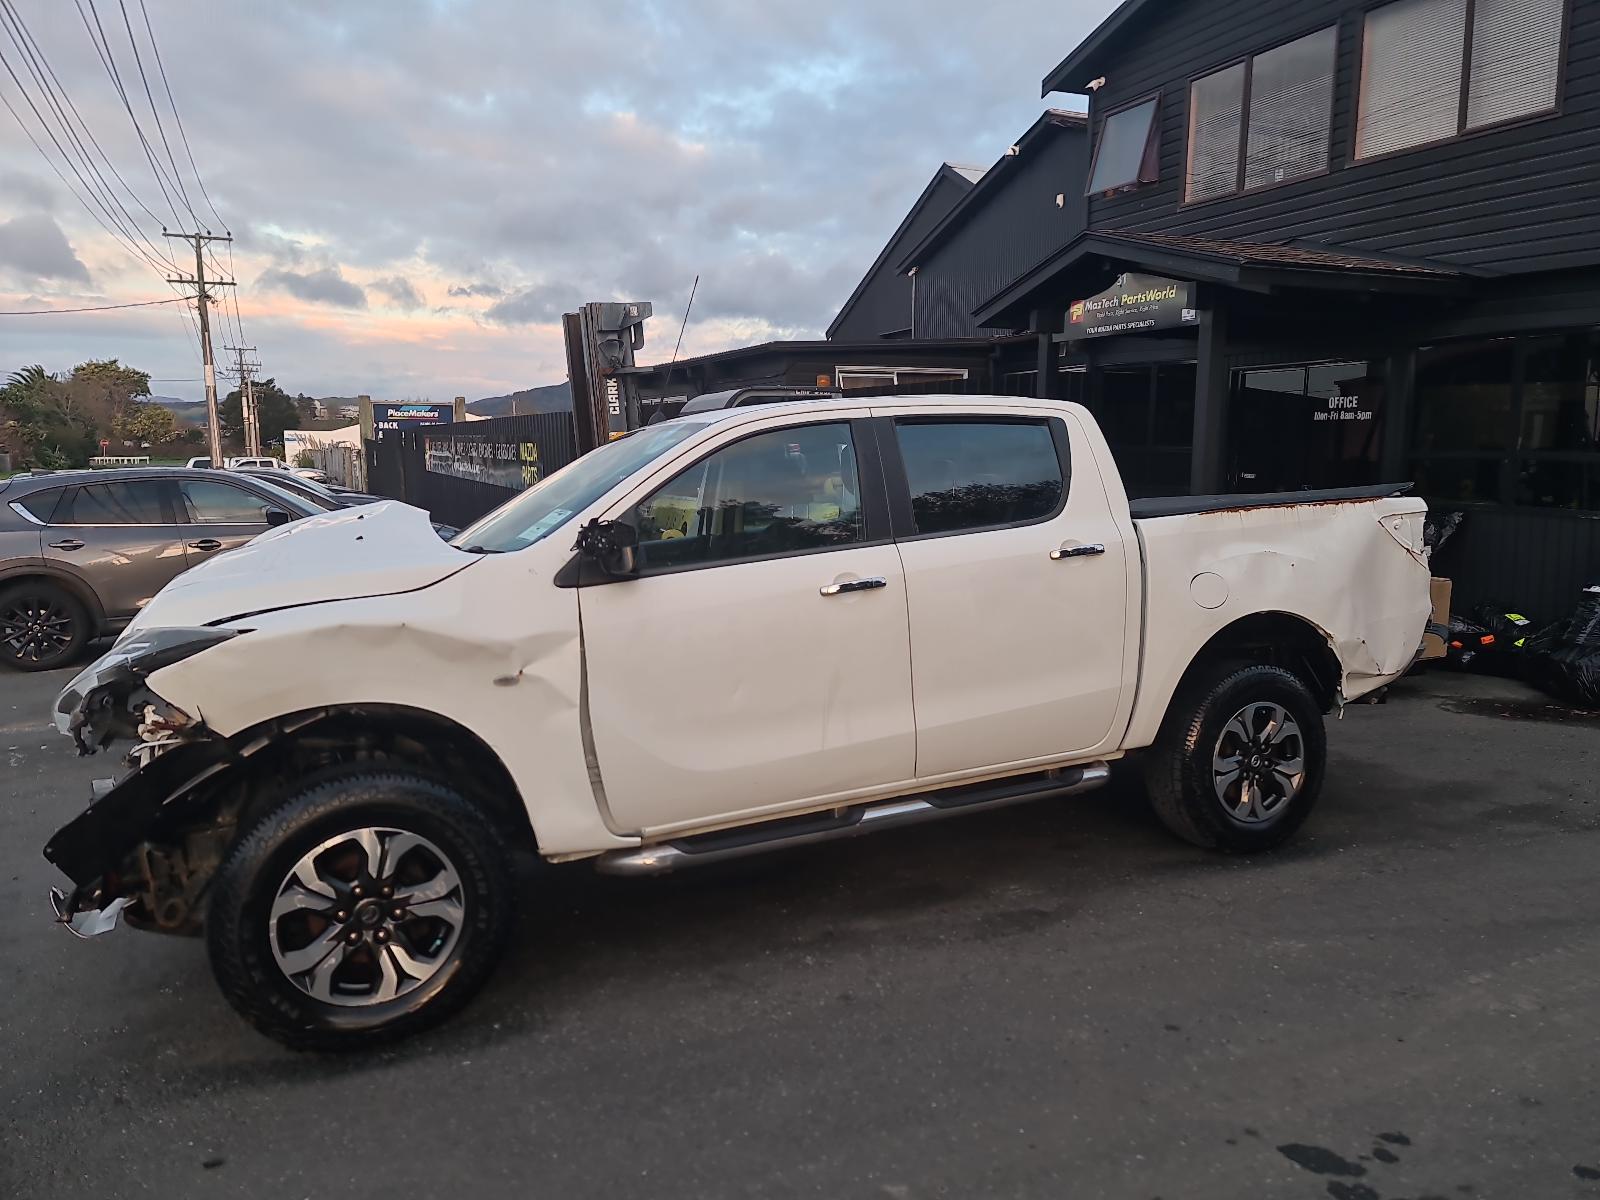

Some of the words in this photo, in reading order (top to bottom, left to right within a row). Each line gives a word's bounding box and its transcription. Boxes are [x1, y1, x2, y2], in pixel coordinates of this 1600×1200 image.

[1084, 296, 1119, 312] MazTech
[1120, 285, 1177, 306] PartsWorld
[1127, 320, 1156, 329] SPECIALISTS
[607, 378, 620, 415] CLARK
[1328, 396, 1359, 409] OFFICE
[387, 408, 438, 418] PlaceMakers
[1314, 411, 1339, 421] Mon-Fri
[1340, 410, 1372, 421] 8am-5pm
[520, 442, 538, 462] MAZDA
[522, 465, 538, 485] PARTS
